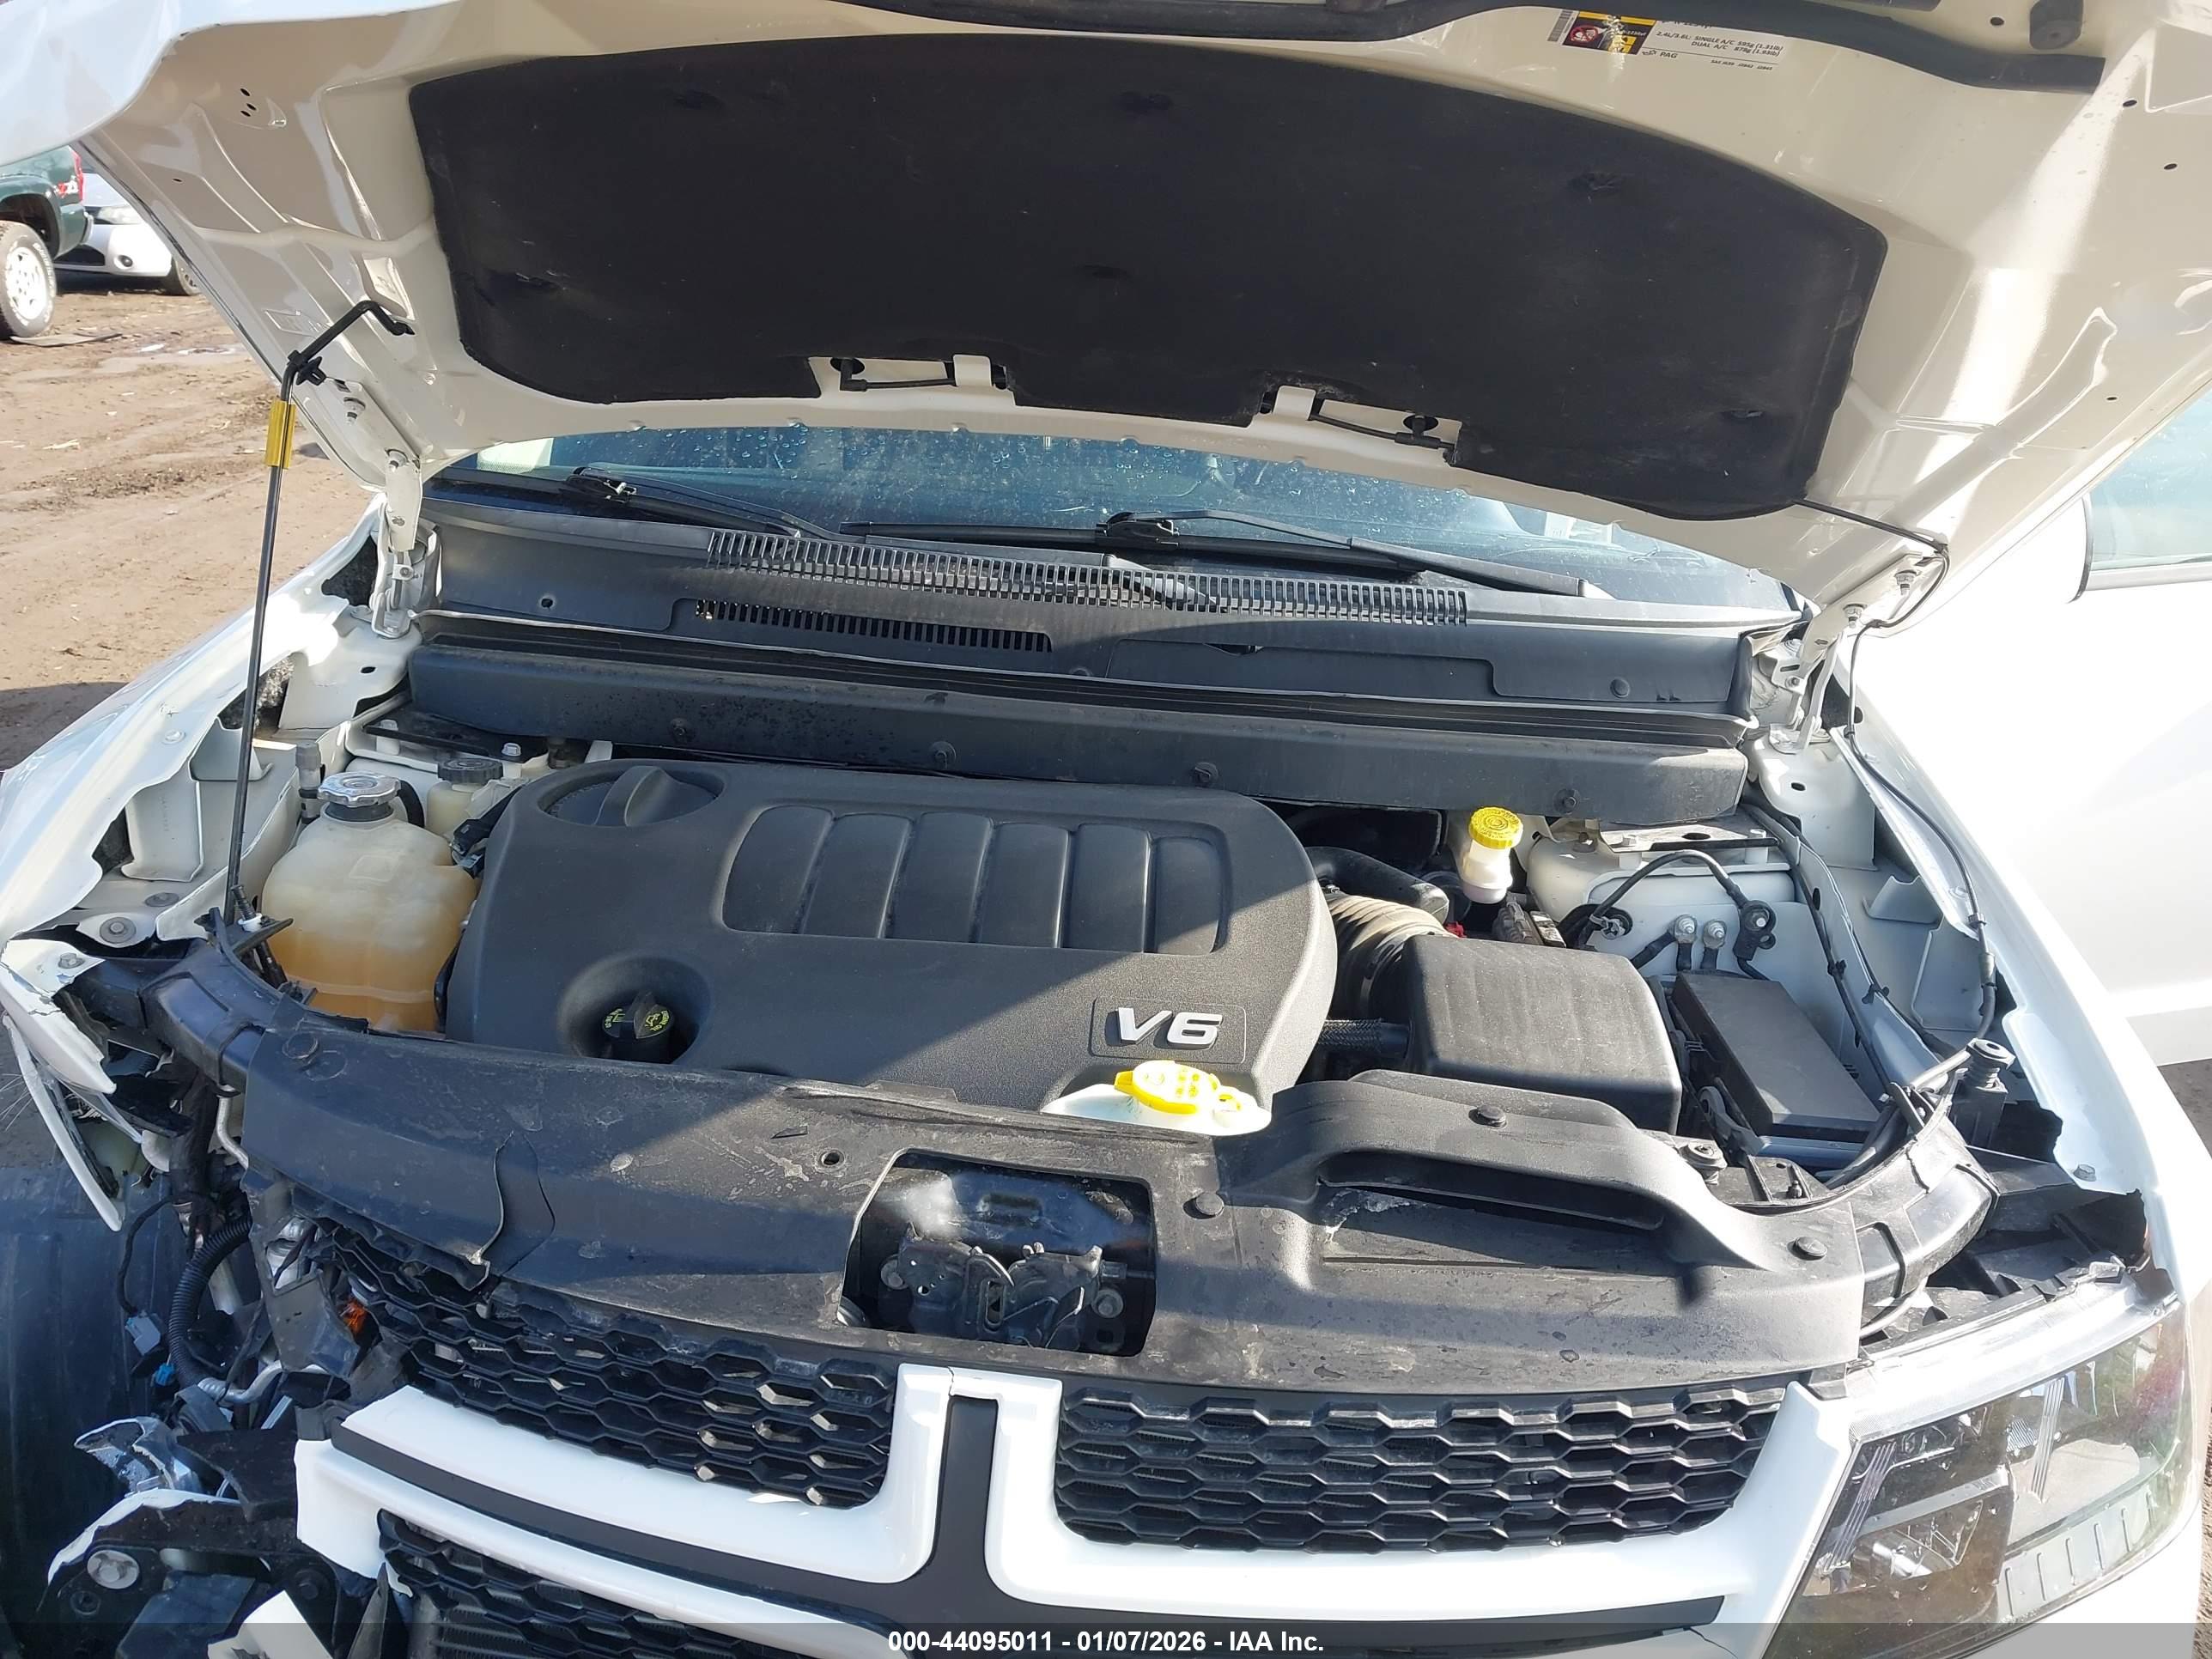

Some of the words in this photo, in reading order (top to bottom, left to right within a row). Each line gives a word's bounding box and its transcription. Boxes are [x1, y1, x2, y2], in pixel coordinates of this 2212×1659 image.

[1694, 35, 1720, 44] SINGLE
[1659, 51, 1678, 59] PAG
[1118, 1007, 1223, 1050] V6
